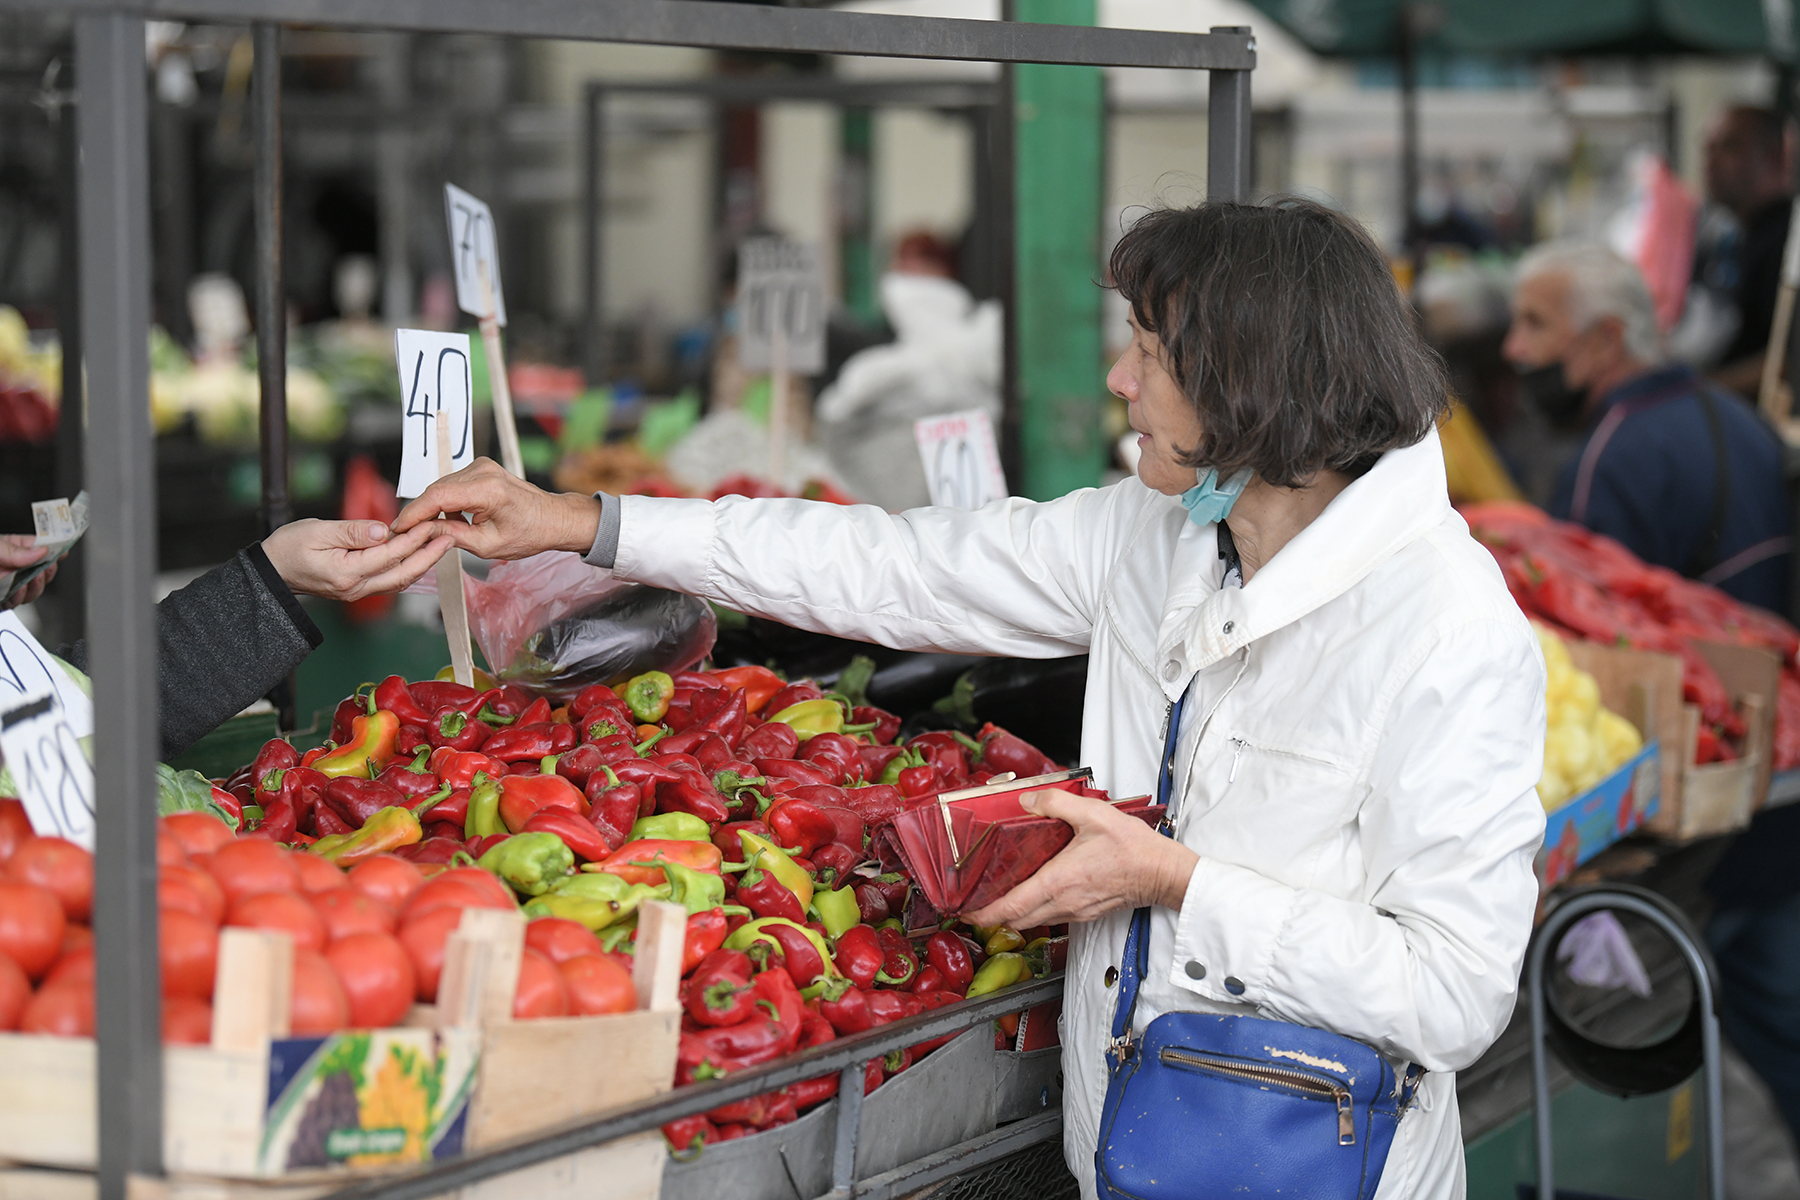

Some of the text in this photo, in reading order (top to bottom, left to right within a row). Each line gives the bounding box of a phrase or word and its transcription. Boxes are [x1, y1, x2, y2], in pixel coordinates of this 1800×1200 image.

[453, 203, 498, 293] 70
[405, 347, 469, 460] 40
[933, 438, 981, 509] 60
